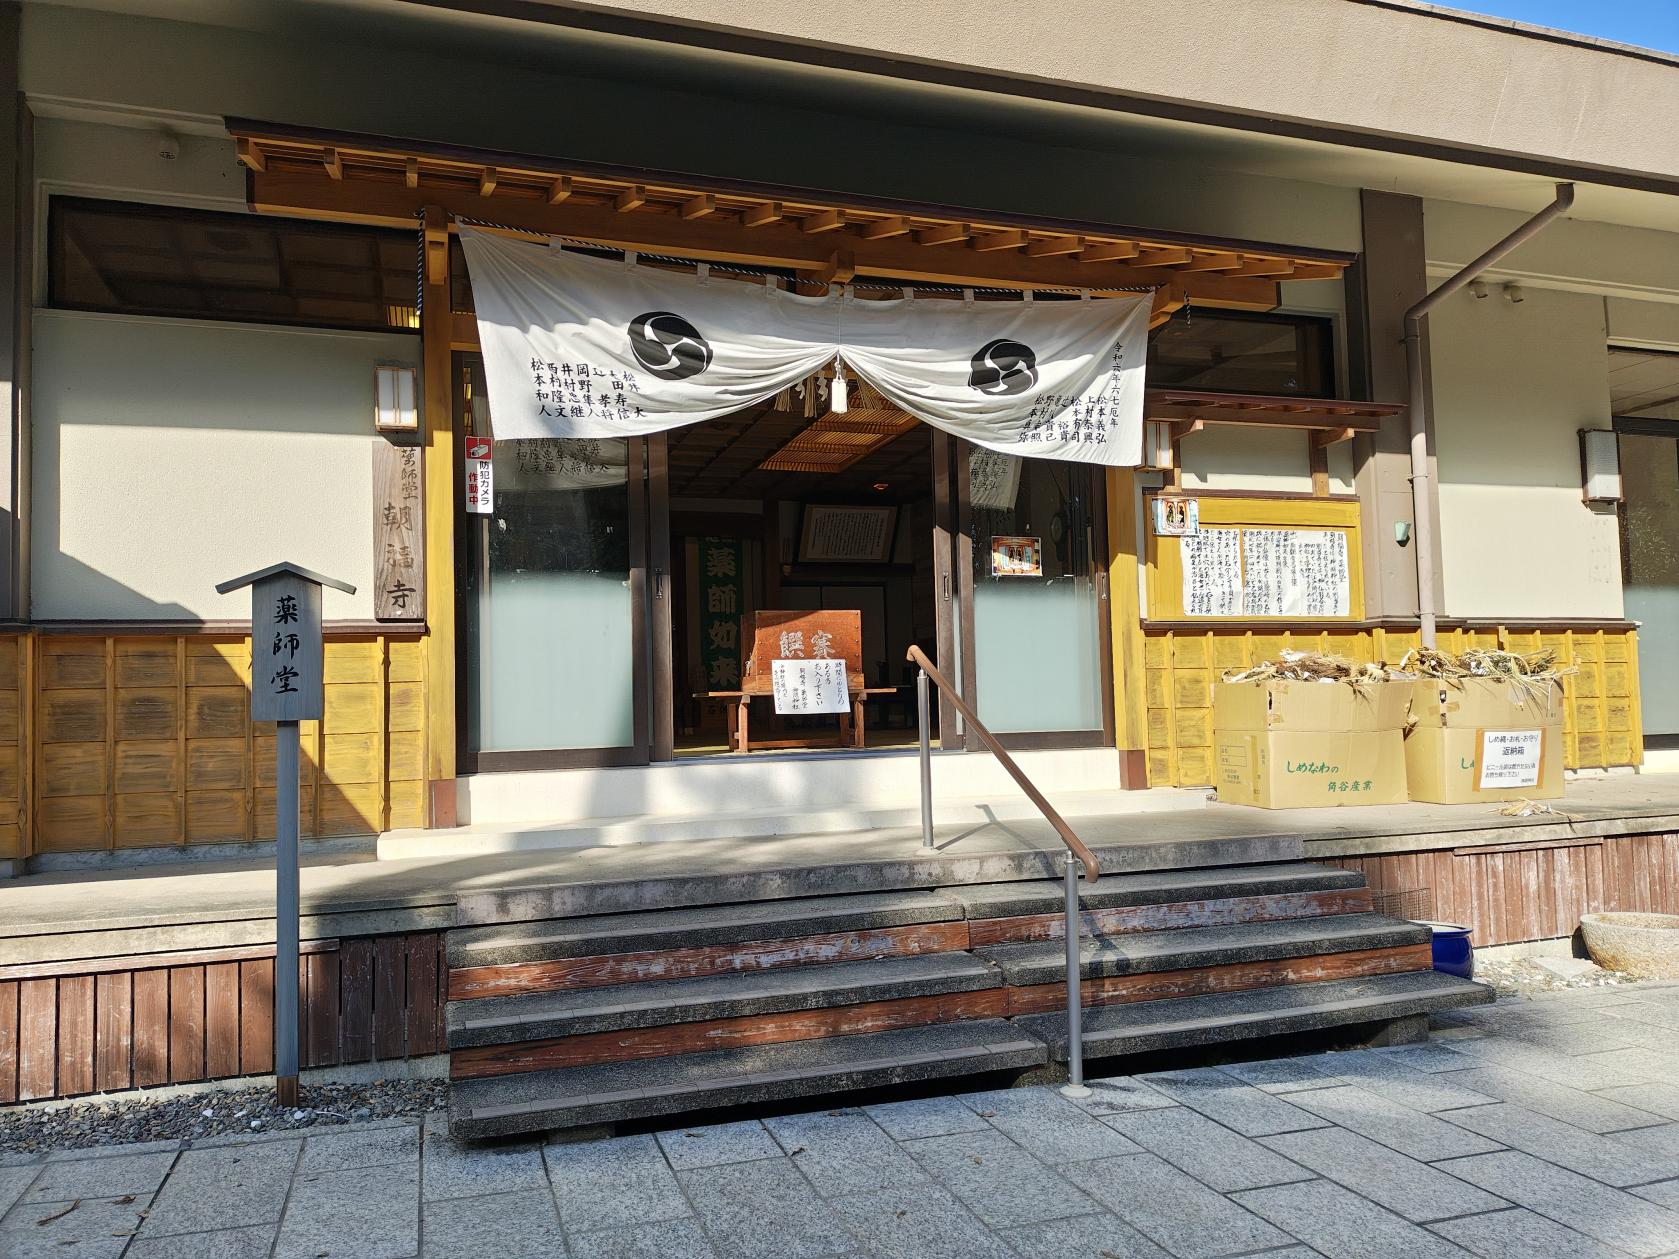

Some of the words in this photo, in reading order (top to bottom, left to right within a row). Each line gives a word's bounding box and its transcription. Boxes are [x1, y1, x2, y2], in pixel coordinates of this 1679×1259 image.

[468, 472, 478, 505] 作動中
[479, 460, 490, 505] 防犯カメラ
[706, 536, 738, 686] 薬師如来
[271, 595, 300, 695] 薬師堂
[1286, 760, 1339, 774] しめなわの
